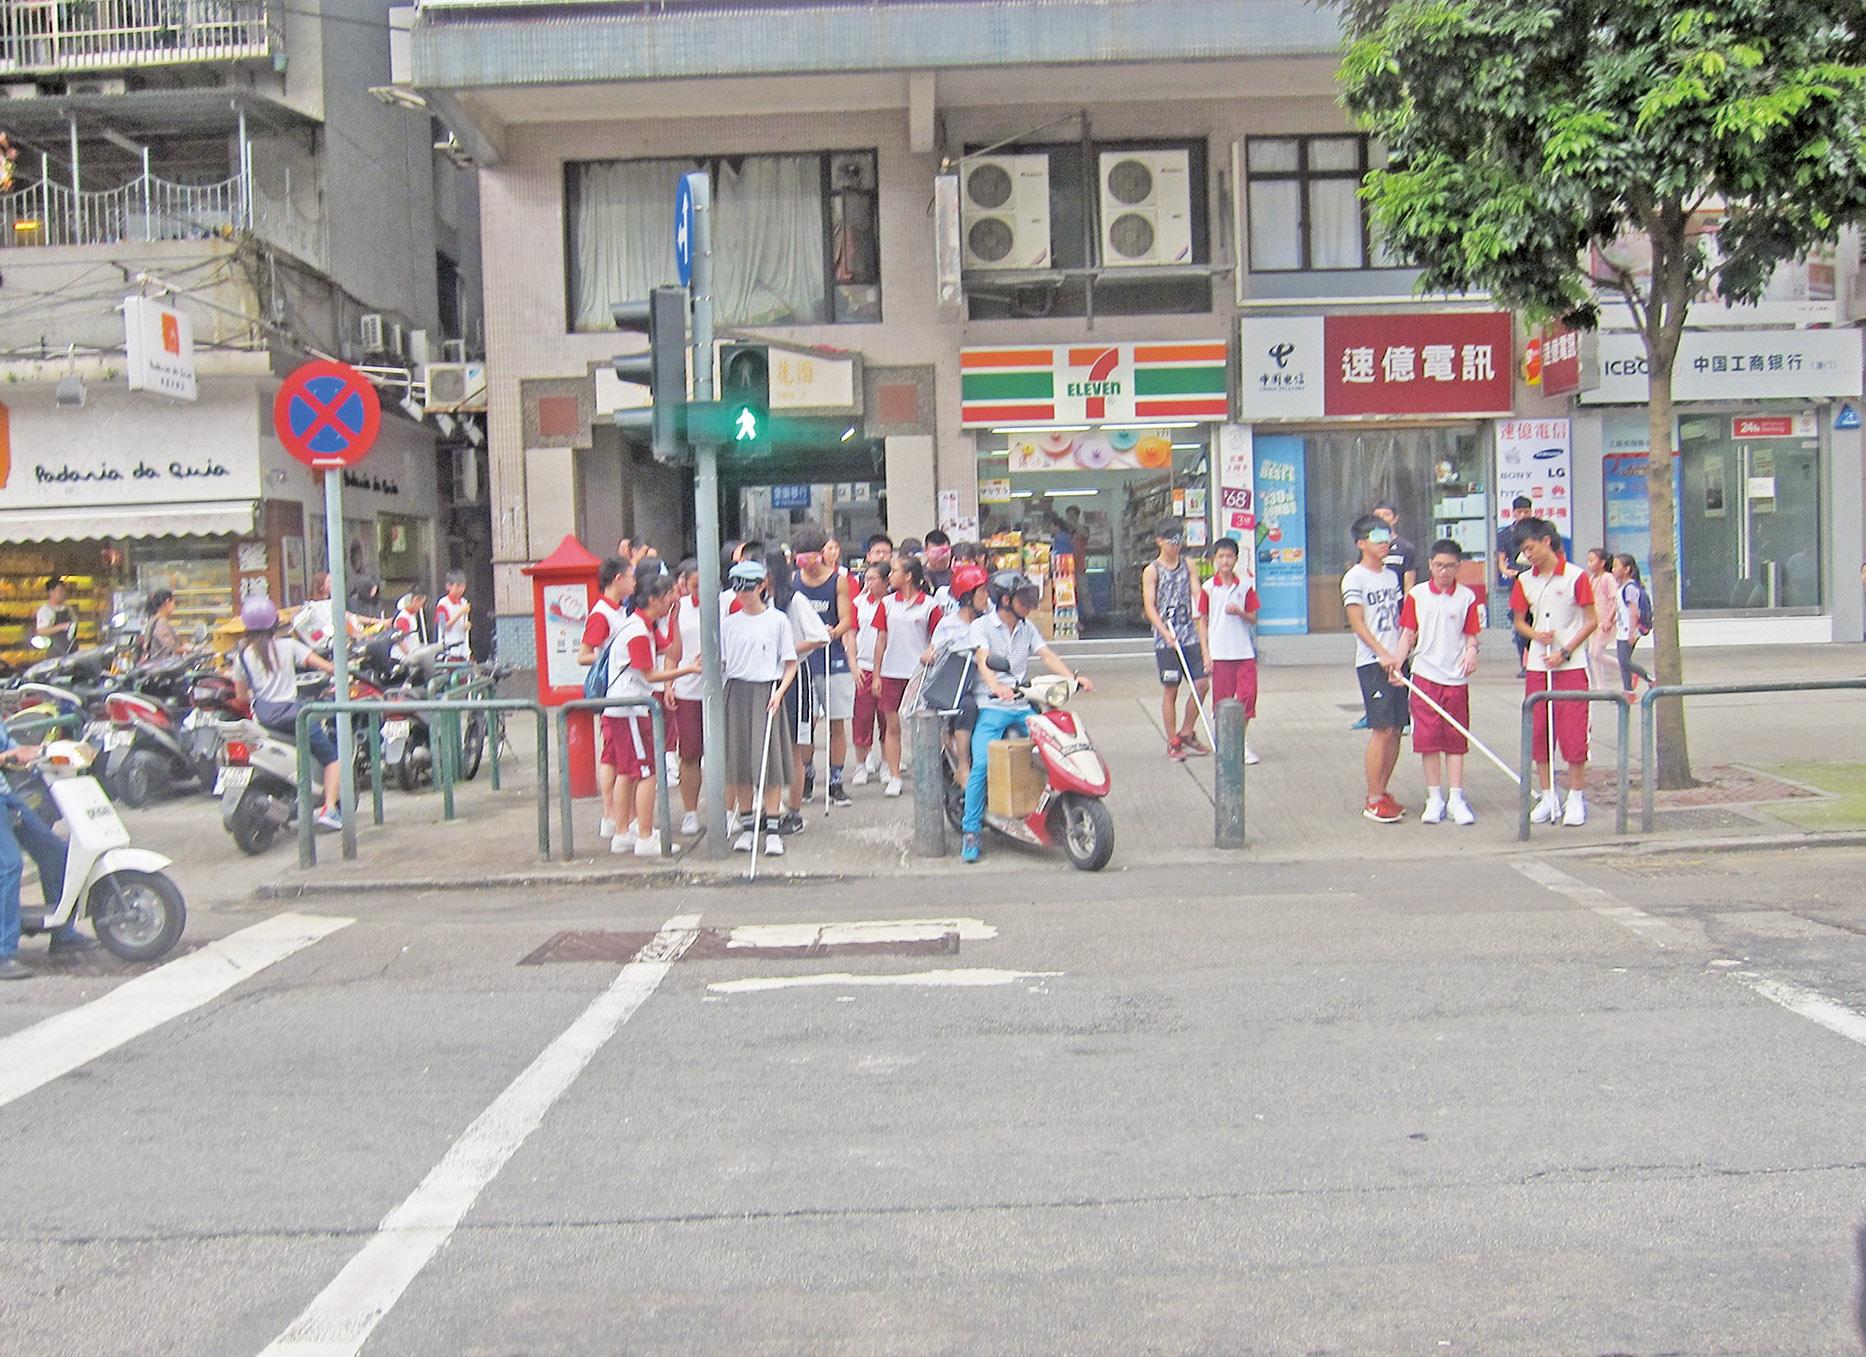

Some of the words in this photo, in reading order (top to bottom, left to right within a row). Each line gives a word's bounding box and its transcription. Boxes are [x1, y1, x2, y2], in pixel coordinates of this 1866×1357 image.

[1342, 344, 1496, 384] 速億電訊
[1693, 354, 1803, 373] 中国工商银行
[1501, 471, 1534, 480] SONY
[1547, 467, 1566, 478] LG
